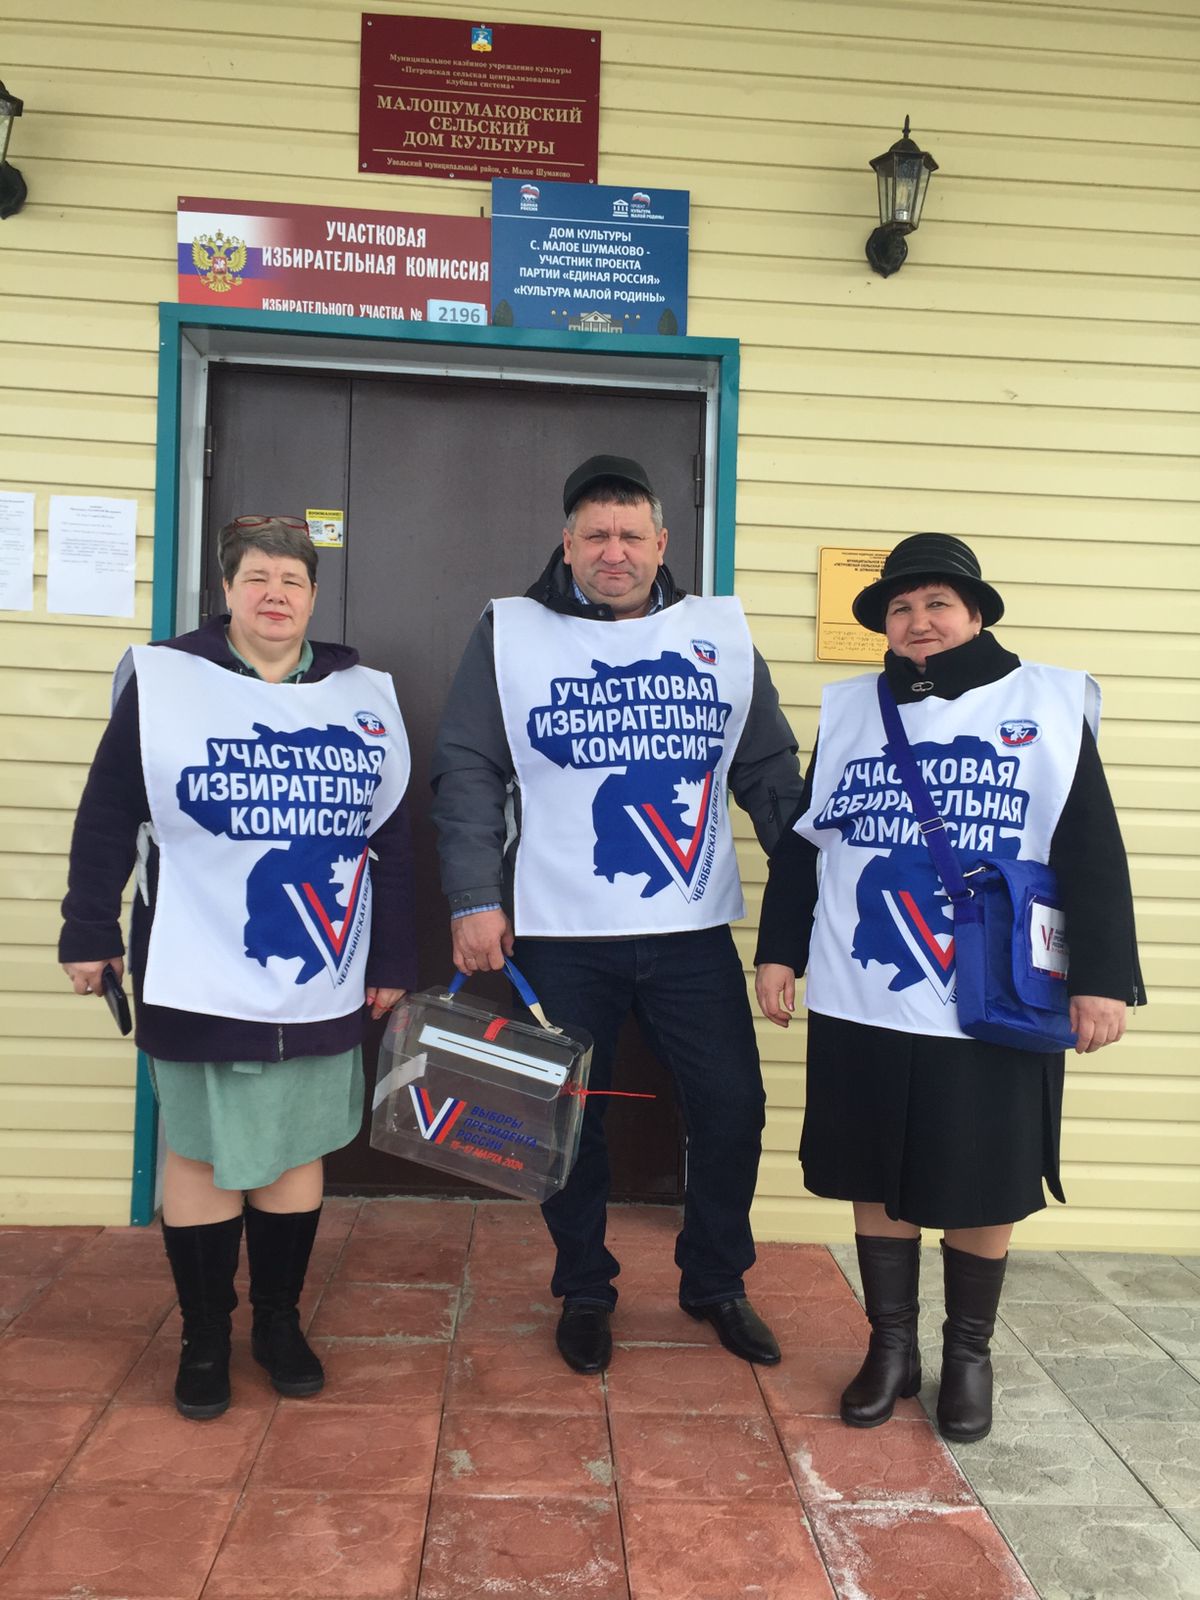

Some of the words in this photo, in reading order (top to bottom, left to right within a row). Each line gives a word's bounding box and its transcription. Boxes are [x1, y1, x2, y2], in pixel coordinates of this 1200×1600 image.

[389, 53, 451, 66] Муниципальное
[489, 62, 534, 72] учреждение
[535, 66, 572, 75] культуры
[453, 70, 487, 79] сельская
[489, 73, 560, 84] централизованная
[446, 78, 477, 87] клубная
[377, 95, 583, 124] МАЛОШУМАКОВСКИЙ
[430, 116, 529, 136] СЕЛЬСКИЙ
[402, 131, 443, 147] ДОМ
[451, 135, 555, 155] КУЛЬТУРЫ
[386, 156, 422, 168] Увельский
[425, 161, 478, 171] муниципальный
[512, 166, 534, 175] Малое
[536, 168, 571, 178] Шумаково
[326, 220, 426, 248] УЧАСТКОВАЯ
[549, 227, 574, 239] ДОМ
[577, 229, 631, 242] КУЛЬТУРЫ
[530, 239, 540, 251] С.
[543, 240, 579, 252] МАЛОЕ
[582, 243, 644, 257] ШУМАКОВО
[262, 246, 396, 275] ИЗБИРАТЕЛЬНАЯ
[406, 256, 489, 282] КОМИССИЯ
[539, 254, 592, 267] УЧАСТНИК
[595, 257, 641, 270] ПРОЕКТА
[519, 267, 560, 279] ПАРТИИ
[563, 270, 610, 282] «ЕДИНАЯ
[613, 272, 660, 285] РОССИЯ»
[513, 285, 571, 297] «КУЛЬТУРА
[573, 286, 611, 300] МАЛОЙ
[614, 290, 665, 303] РОДИНЫ»
[262, 298, 354, 317] ИЗБИРАТЕЛЬНОГО
[359, 303, 404, 320] УЧАСТКА
[410, 307, 422, 321] №
[438, 306, 480, 323] 2196
[554, 674, 715, 706] УЧАСТКОВАЯ
[535, 704, 727, 739] ИЗБИРАТЕЛЬНАЯ
[211, 742, 384, 775] УЧАСТКОВАЯ
[571, 734, 707, 764] КОМИССИЯ
[842, 757, 1016, 790] УЧАСКОВАЯ
[187, 772, 376, 807] ИЗБИРАТЕЛЬН
[819, 789, 1023, 824] ИЗБИРАЕЛЬНАЯ
[850, 816, 995, 852] КОМИСИЯ
[692, 825, 717, 901] ЧЕЛЯБИНСКАЯ
[337, 903, 366, 986] ЧЕЛЯБИНСКАЯ
[470, 1106, 524, 1130] ВЫБОРЫ
[456, 1129, 503, 1150] РОССИИ
[464, 1118, 537, 1148] ПРЕЗИДЕНТА
